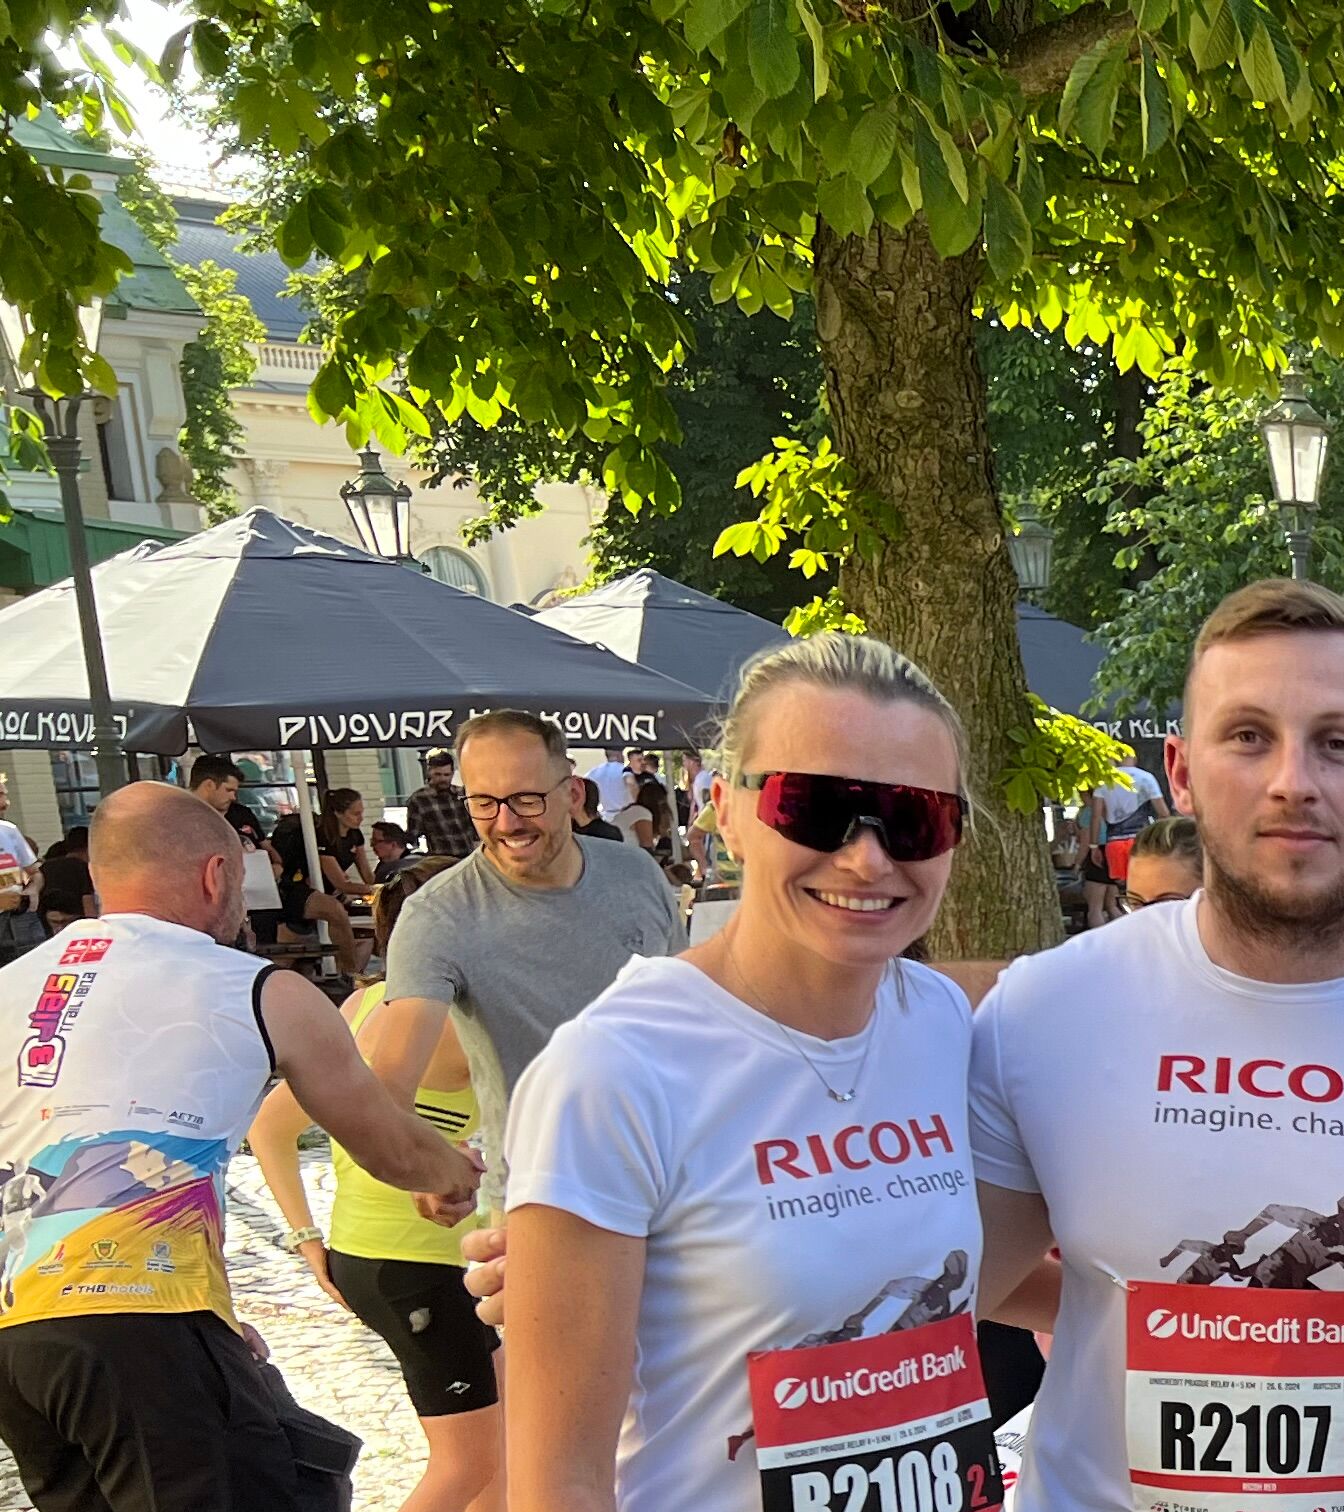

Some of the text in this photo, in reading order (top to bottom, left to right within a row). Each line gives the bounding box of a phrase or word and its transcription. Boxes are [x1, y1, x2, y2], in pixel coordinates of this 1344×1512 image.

[278, 709, 453, 745] PIVOVAR
[1154, 1102, 1283, 1133] imagine.
[753, 1114, 953, 1186] RICOH
[767, 1168, 970, 1221] imagine. change.
[1180, 1313, 1302, 1344] UniCredit
[809, 1345, 967, 1405] UniCredit Bank
[1160, 1400, 1332, 1475] R2107
[966, 1463, 987, 1509] 2
